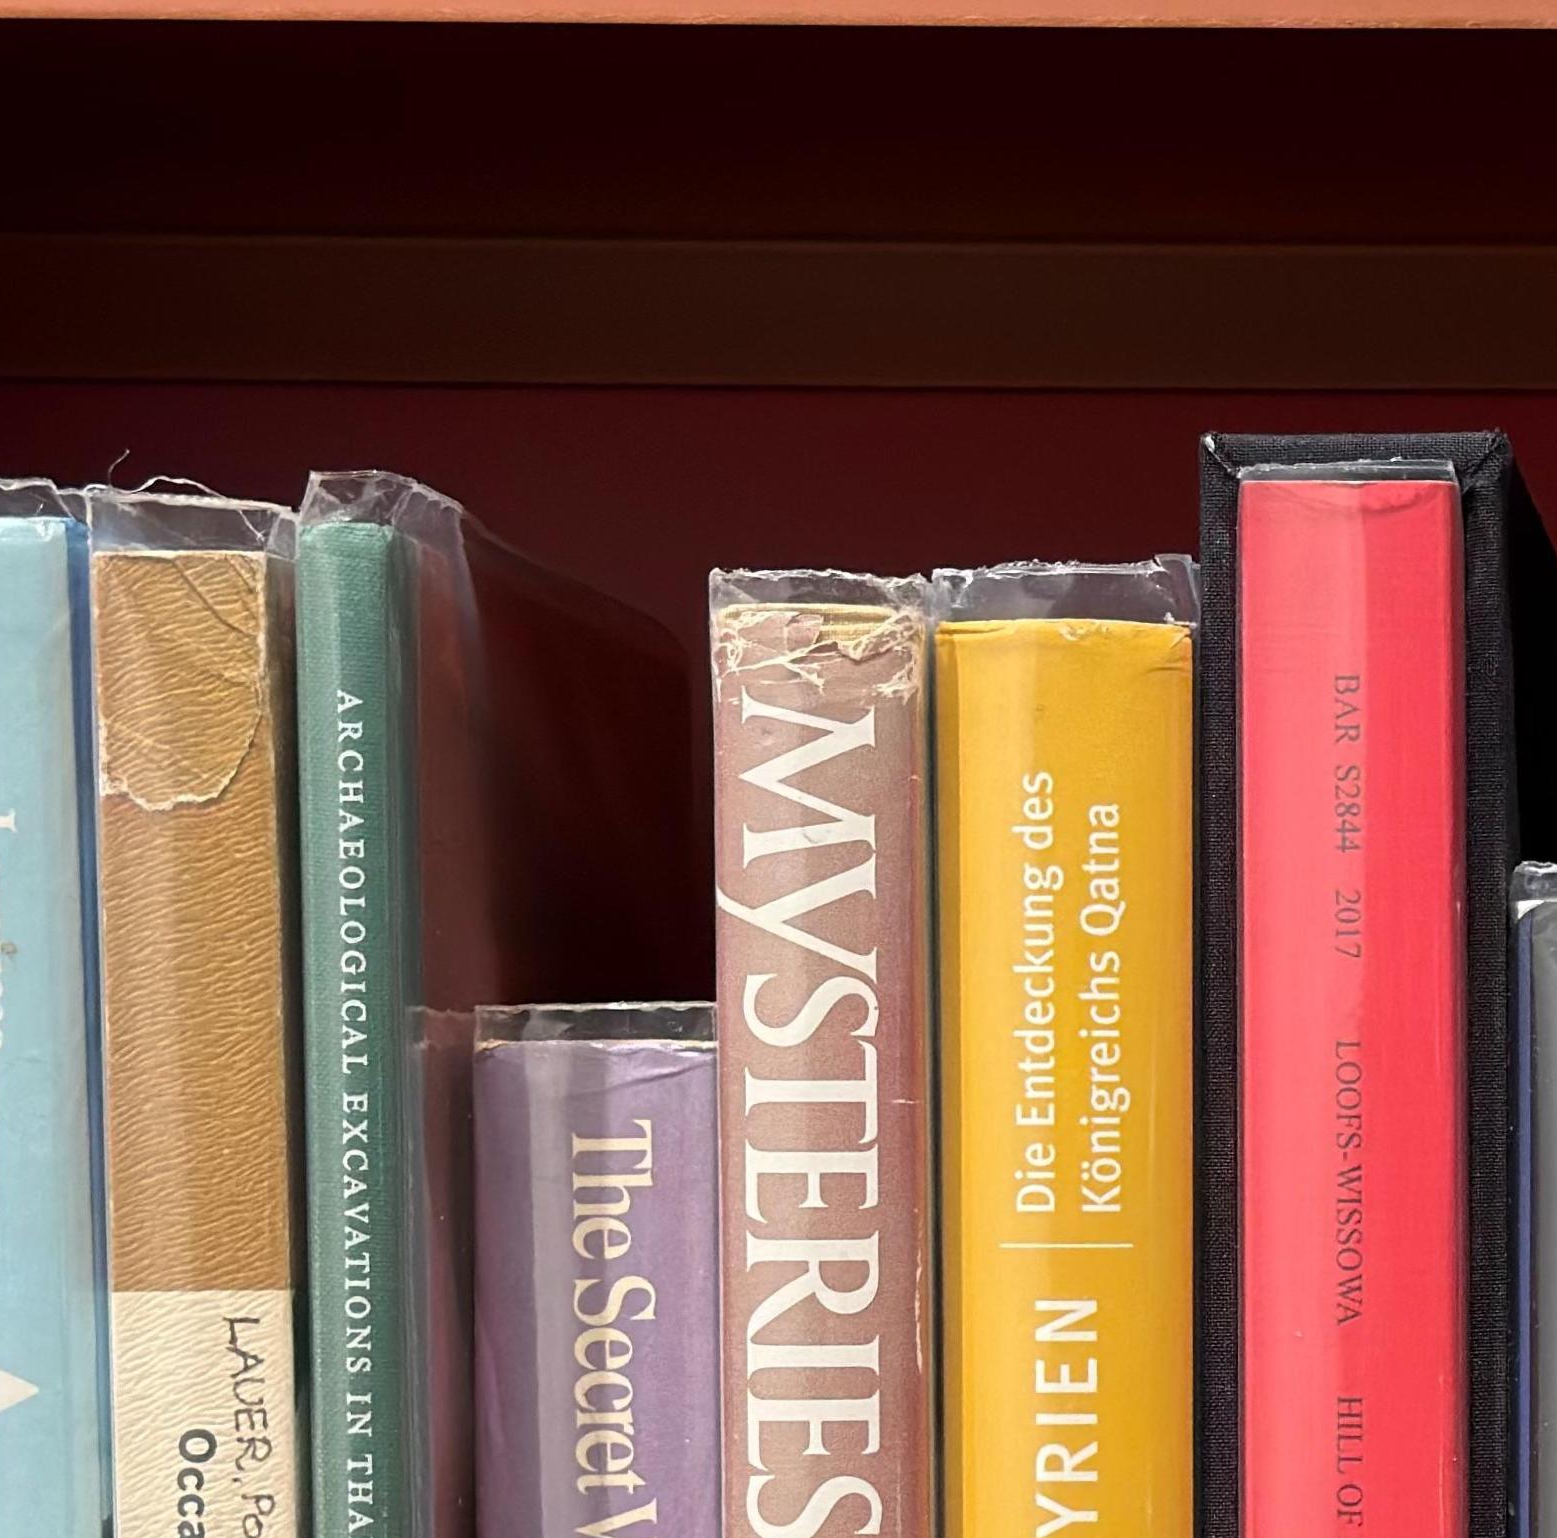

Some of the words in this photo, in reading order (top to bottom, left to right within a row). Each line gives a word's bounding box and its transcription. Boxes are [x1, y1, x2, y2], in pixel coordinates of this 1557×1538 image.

[1011, 770, 1054, 850] des
[1078, 802, 1126, 935] Qatna
[335, 687, 368, 1076] ARCHAEOLOGICAL
[1012, 863, 1065, 1126] Entdeckung
[1077, 949, 1131, 1213] Königreichs
[340, 1091, 372, 1374] EXCAVATIONS
[569, 1117, 655, 1261] The
[1014, 1141, 1056, 1213] Die
[346, 1391, 373, 1438] IN
[571, 1272, 657, 1495] Secret
[1336, 1395, 1364, 1475] HILL
[1336, 1482, 1364, 1527] OF
